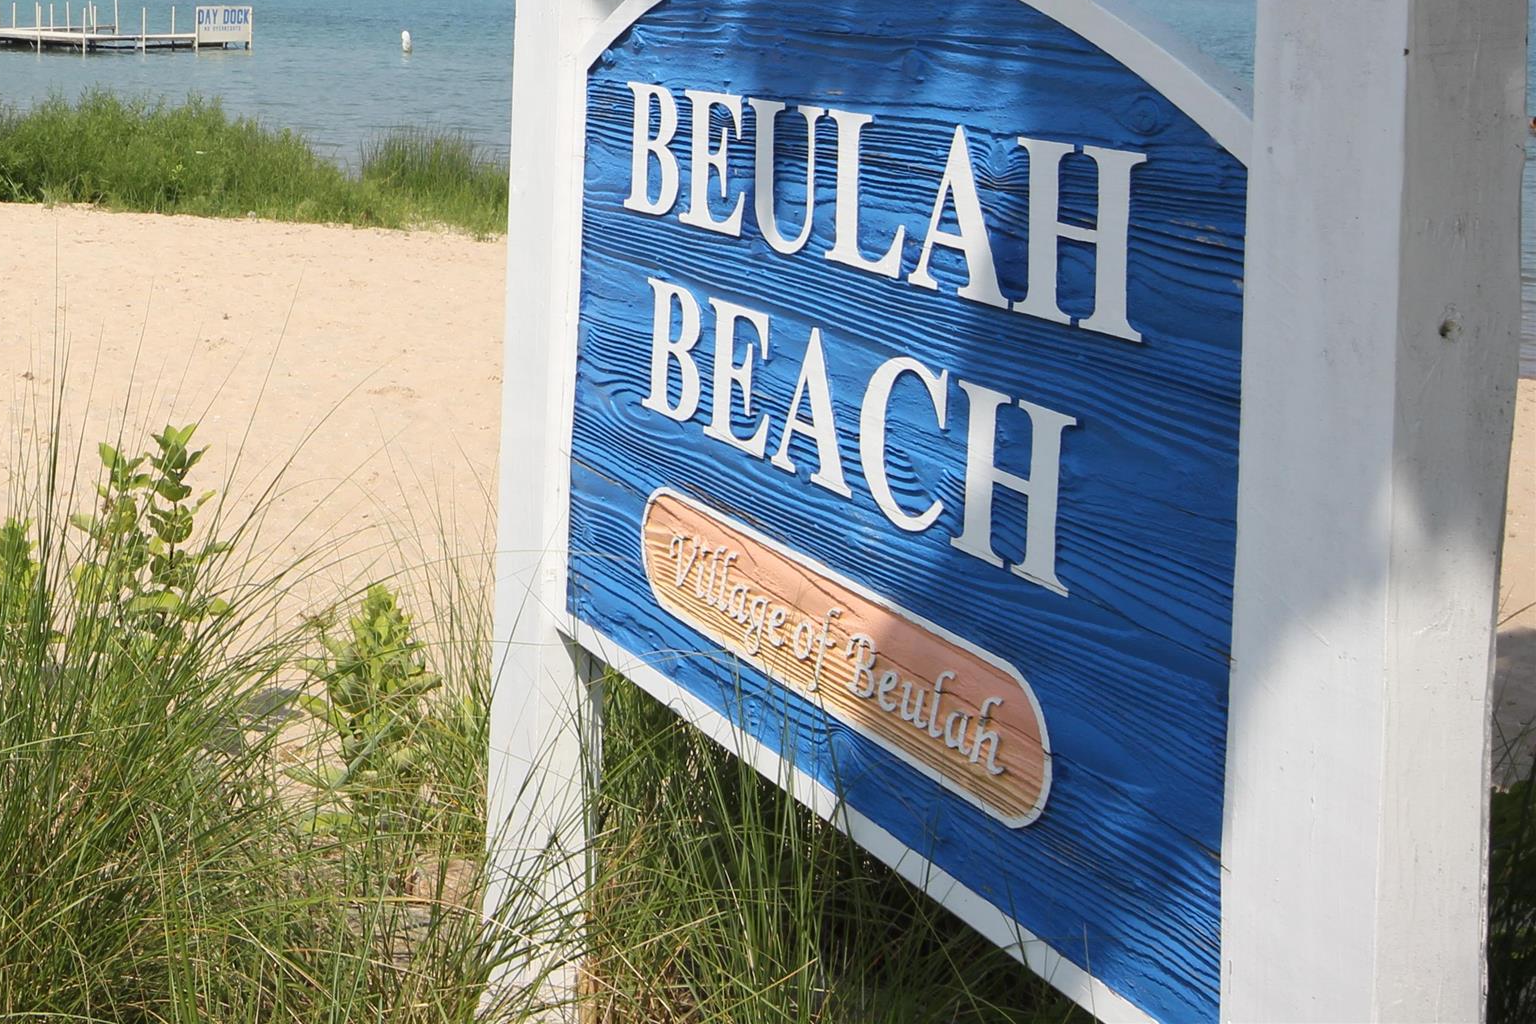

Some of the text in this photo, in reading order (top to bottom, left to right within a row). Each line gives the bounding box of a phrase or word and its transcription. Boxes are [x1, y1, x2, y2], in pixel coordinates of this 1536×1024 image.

[198, 9, 250, 24] DAY DOCK
[623, 81, 1147, 343] BEULAH
[641, 277, 1078, 597] BEACH
[670, 534, 1005, 775] Village of Beulah
